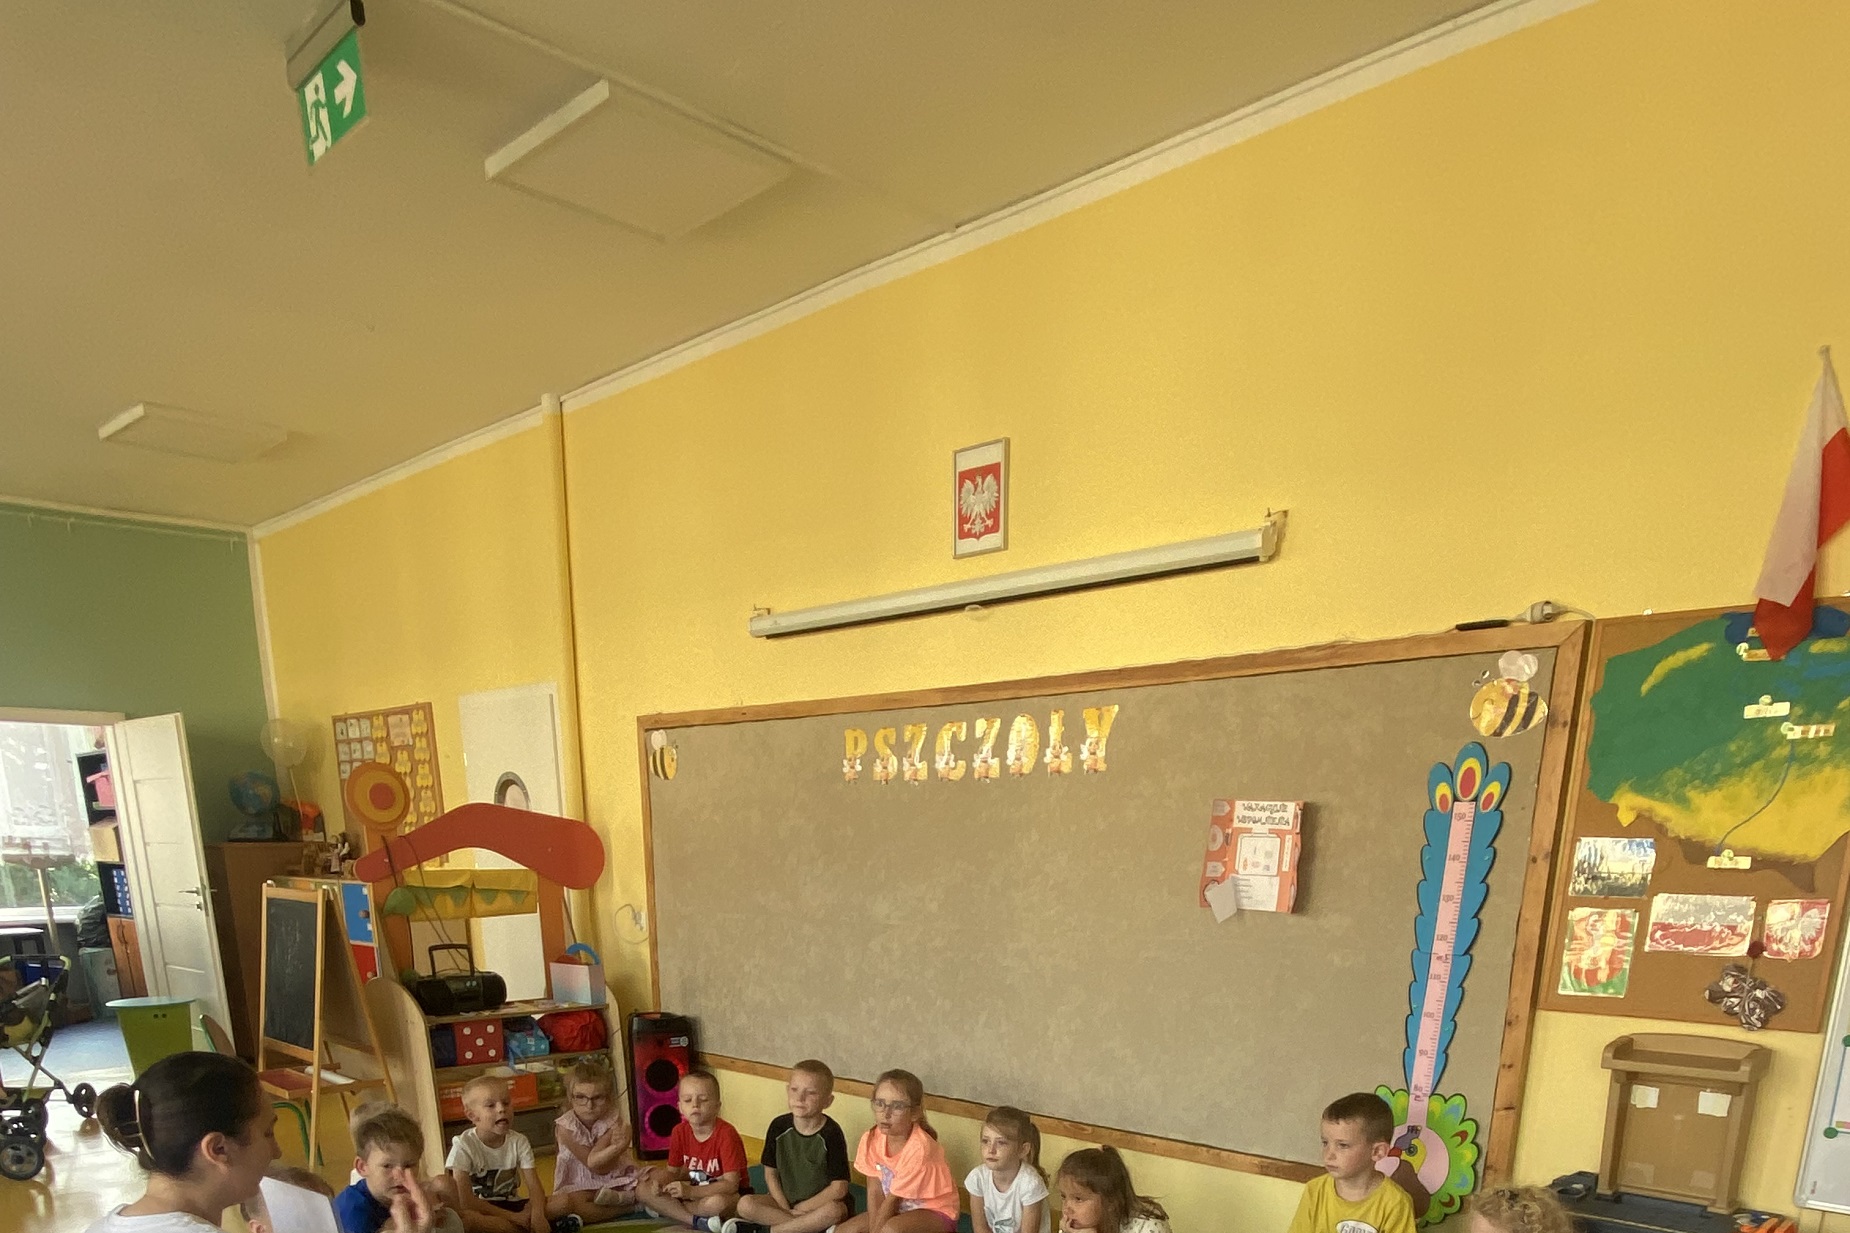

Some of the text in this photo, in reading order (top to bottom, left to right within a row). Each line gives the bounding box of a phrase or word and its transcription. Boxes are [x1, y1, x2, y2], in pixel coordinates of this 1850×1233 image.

[1453, 812, 1467, 821] 150
[1448, 854, 1461, 862] 140
[1423, 1011, 1436, 1019] 100
[1418, 1049, 1429, 1057] 90
[683, 1154, 720, 1173] TEAM
